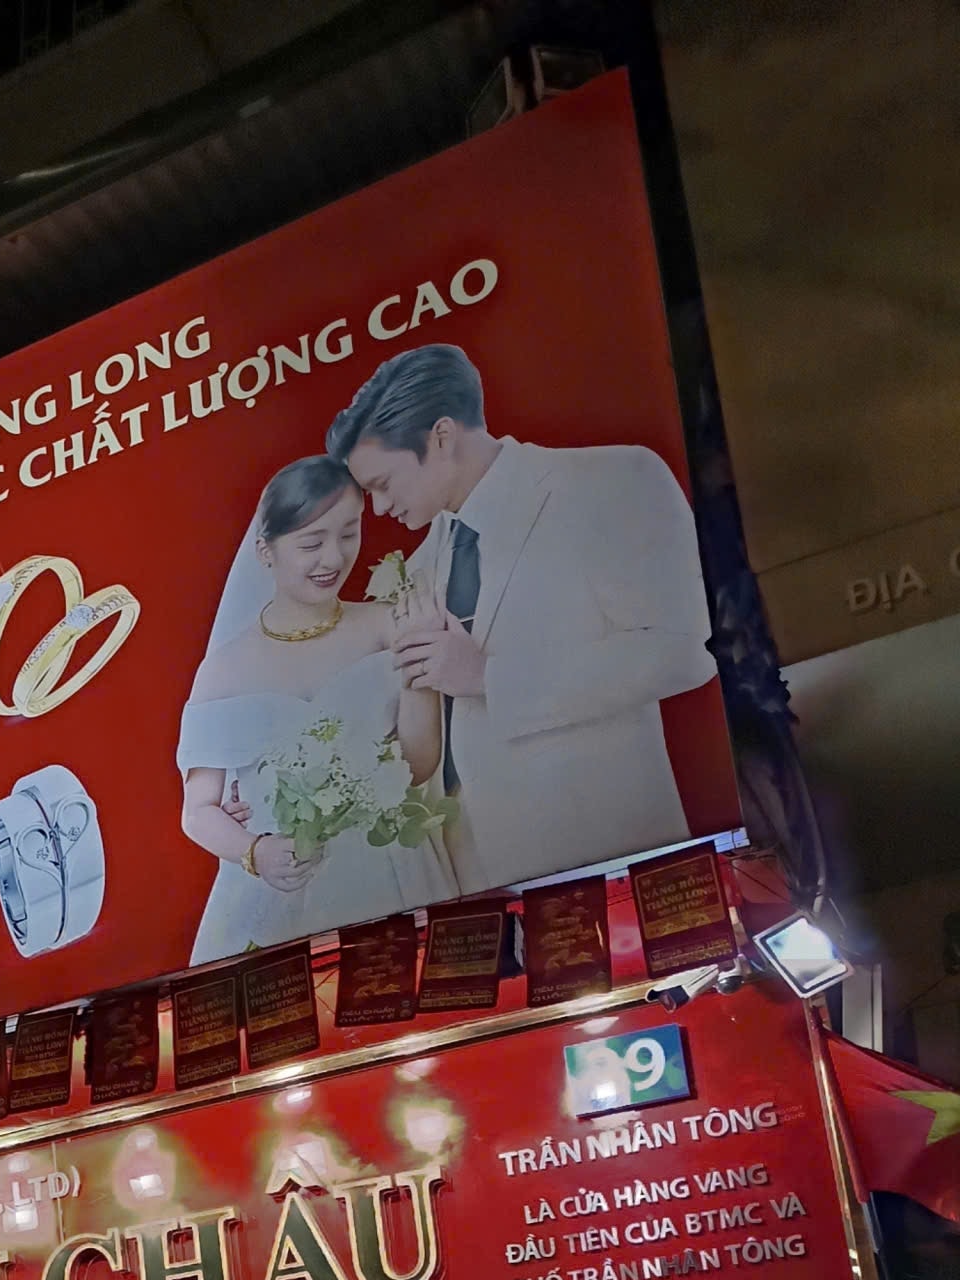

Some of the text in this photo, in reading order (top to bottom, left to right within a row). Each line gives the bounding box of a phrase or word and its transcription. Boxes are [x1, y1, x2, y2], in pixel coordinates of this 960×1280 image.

[19, 401, 150, 488] CHẤT
[162, 316, 354, 432] LƯỢNG
[367, 258, 499, 341] CAO
[69, 316, 211, 409] LONG
[499, 1102, 779, 1176] TRẦN NHÂN TÔNG
[11, 1165, 82, 1209] LTD)
[524, 1199, 556, 1225] LÀ
[559, 1186, 609, 1219] CỬA
[613, 1177, 690, 1209] HÀNG
[505, 1191, 806, 1265] ĐẦU TIÊN CỦA BTMC VÀ
[643, 1249, 720, 1280] NHÂN
[725, 1233, 806, 1265] TÔNG
